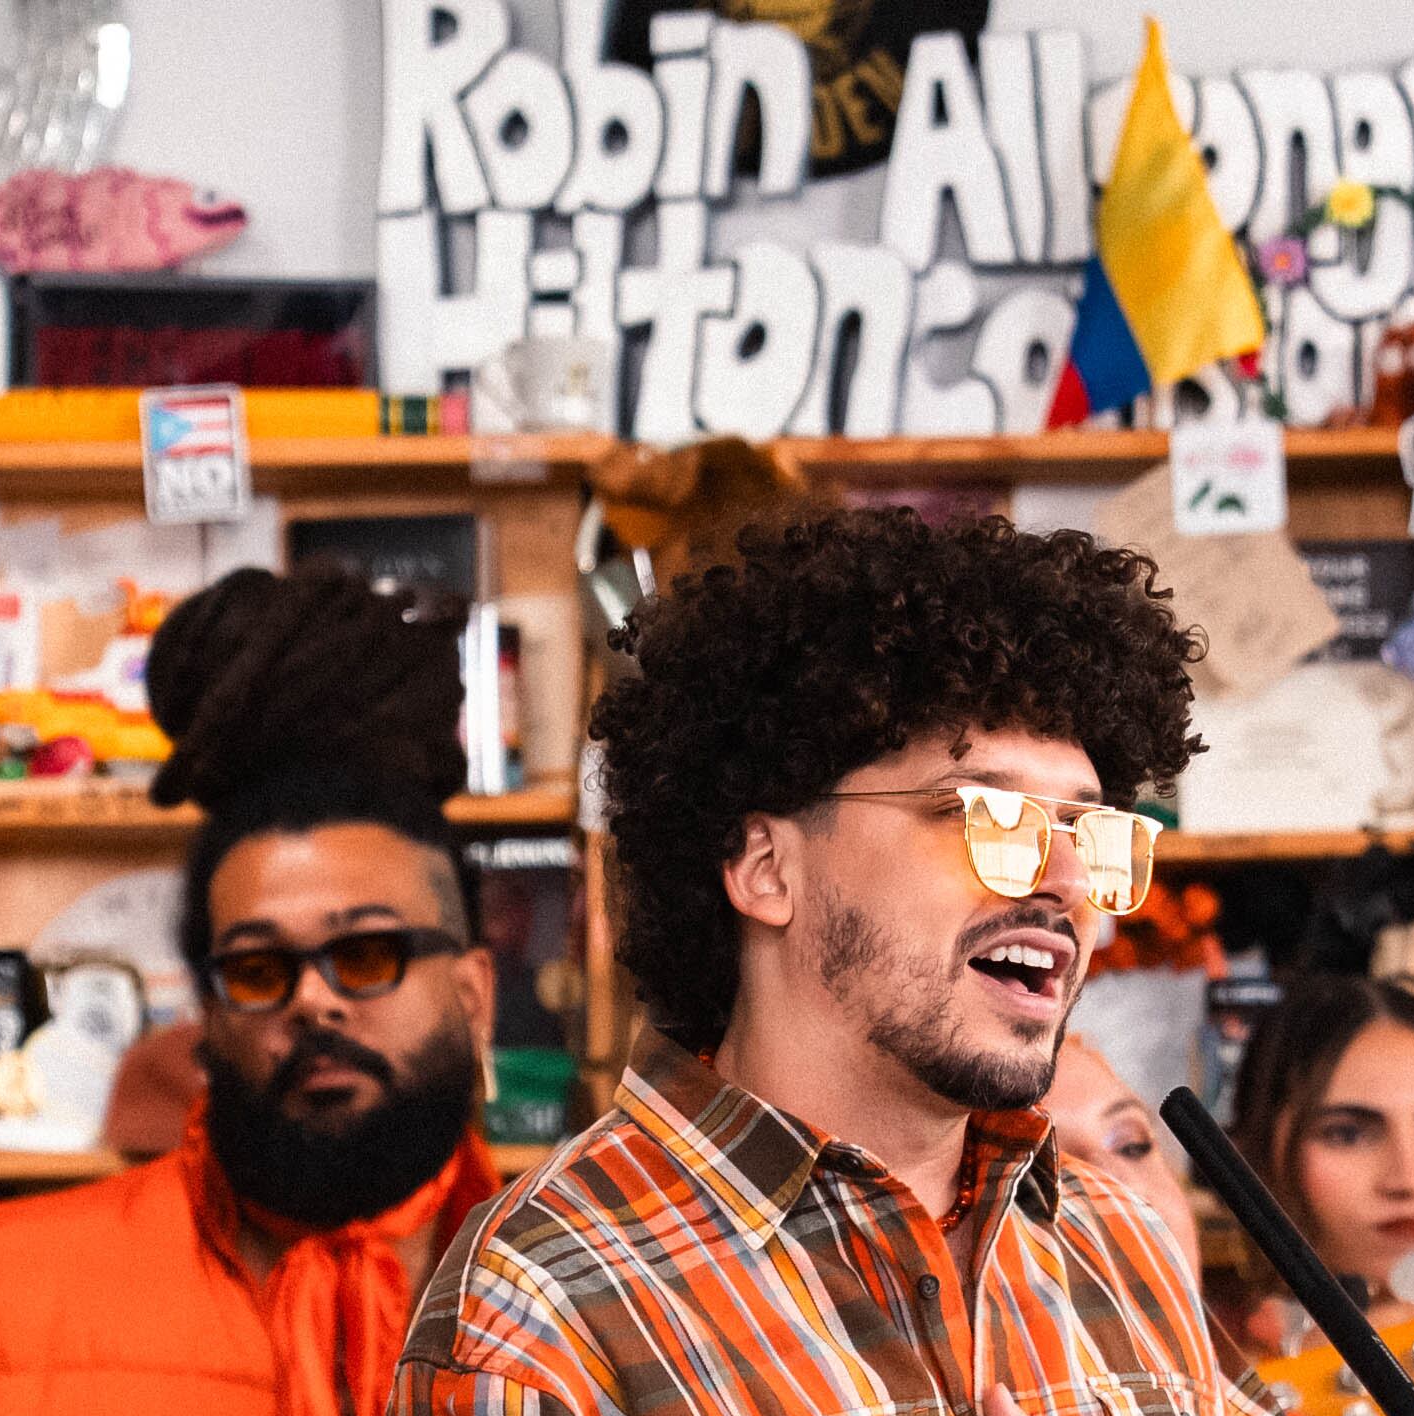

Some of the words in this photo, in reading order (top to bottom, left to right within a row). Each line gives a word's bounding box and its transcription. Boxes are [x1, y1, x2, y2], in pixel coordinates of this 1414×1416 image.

[380, 0, 812, 213] Robin
[882, 28, 1089, 270] All
[375, 200, 919, 445] Hilton
